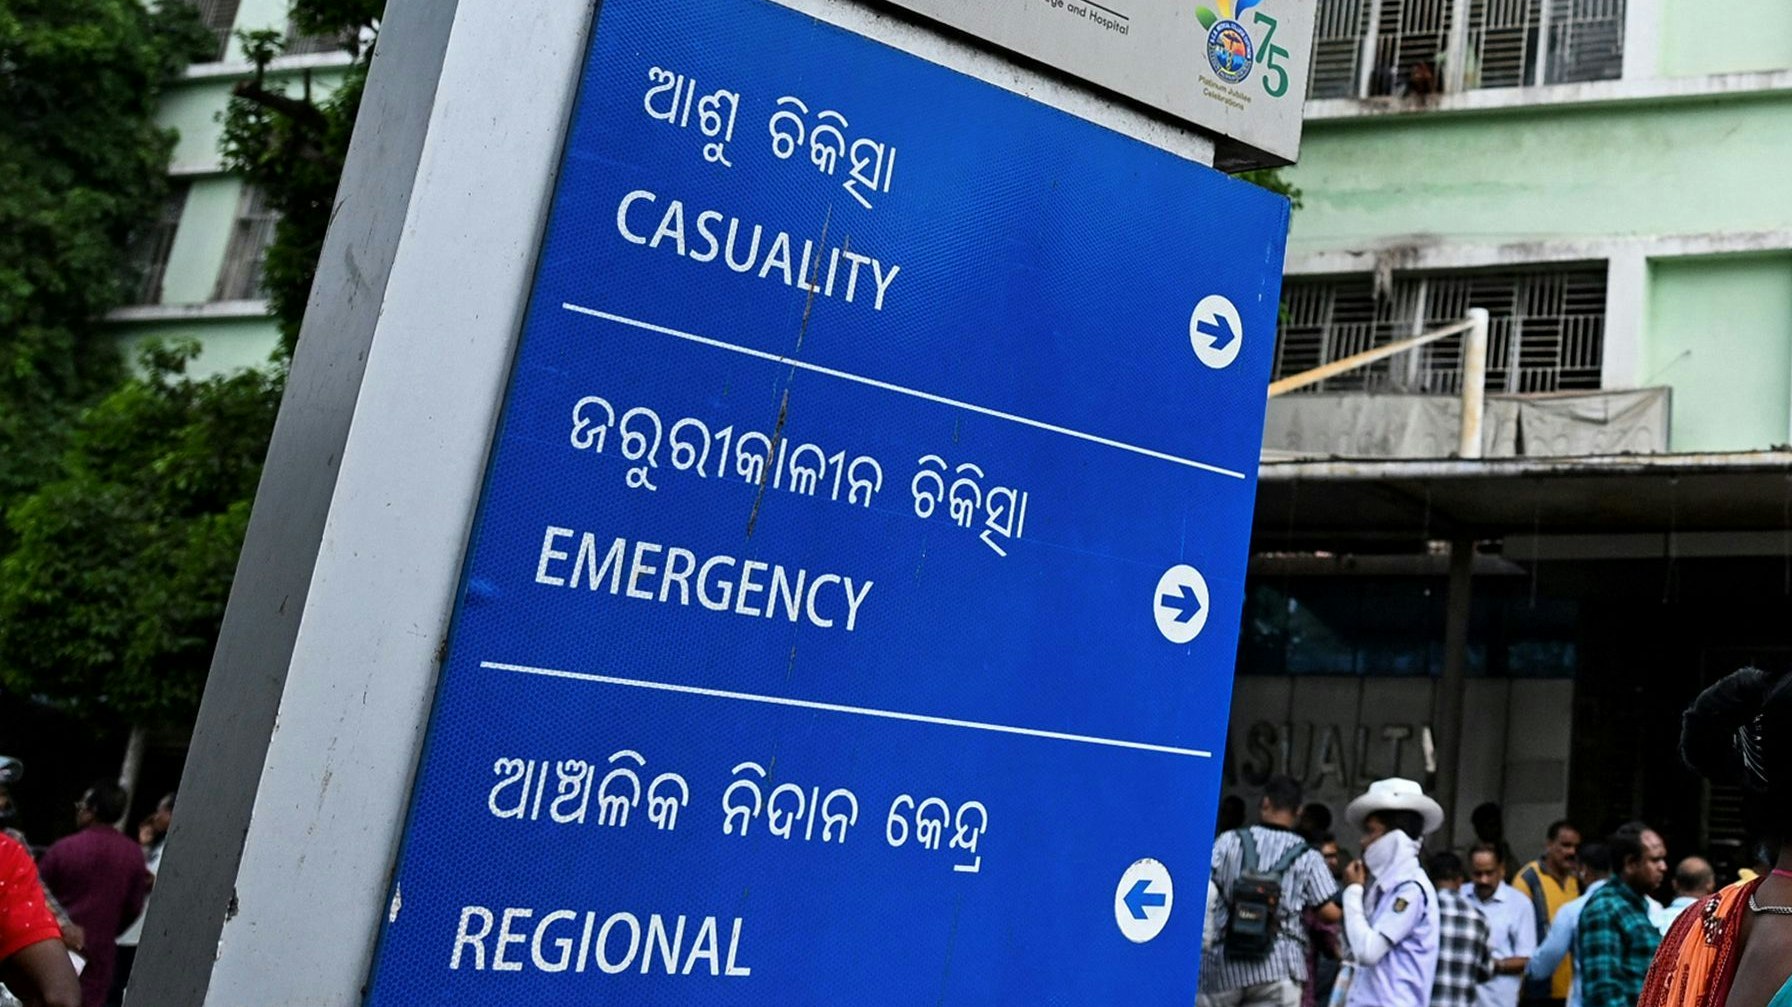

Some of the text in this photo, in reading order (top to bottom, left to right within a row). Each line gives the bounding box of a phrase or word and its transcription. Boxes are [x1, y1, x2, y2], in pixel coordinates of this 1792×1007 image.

[1067, 3, 1087, 18] and
[1089, 10, 1130, 35] Hospital
[1254, 11, 1290, 98] 75
[645, 67, 895, 208] ଆଶୁ ଚିକିତ୍ସା
[617, 189, 900, 310] CASUALITY
[571, 397, 1027, 556] ଜରୁରୀକାଳୀନ ଚିକିତ୍ସା
[535, 527, 873, 630] EMERGENCY
[489, 750, 987, 872] ଆଞ୍ଚଳିକ ନିଦାନ କେନ୍ଦ୍ର
[450, 905, 751, 977] REGIONAL
